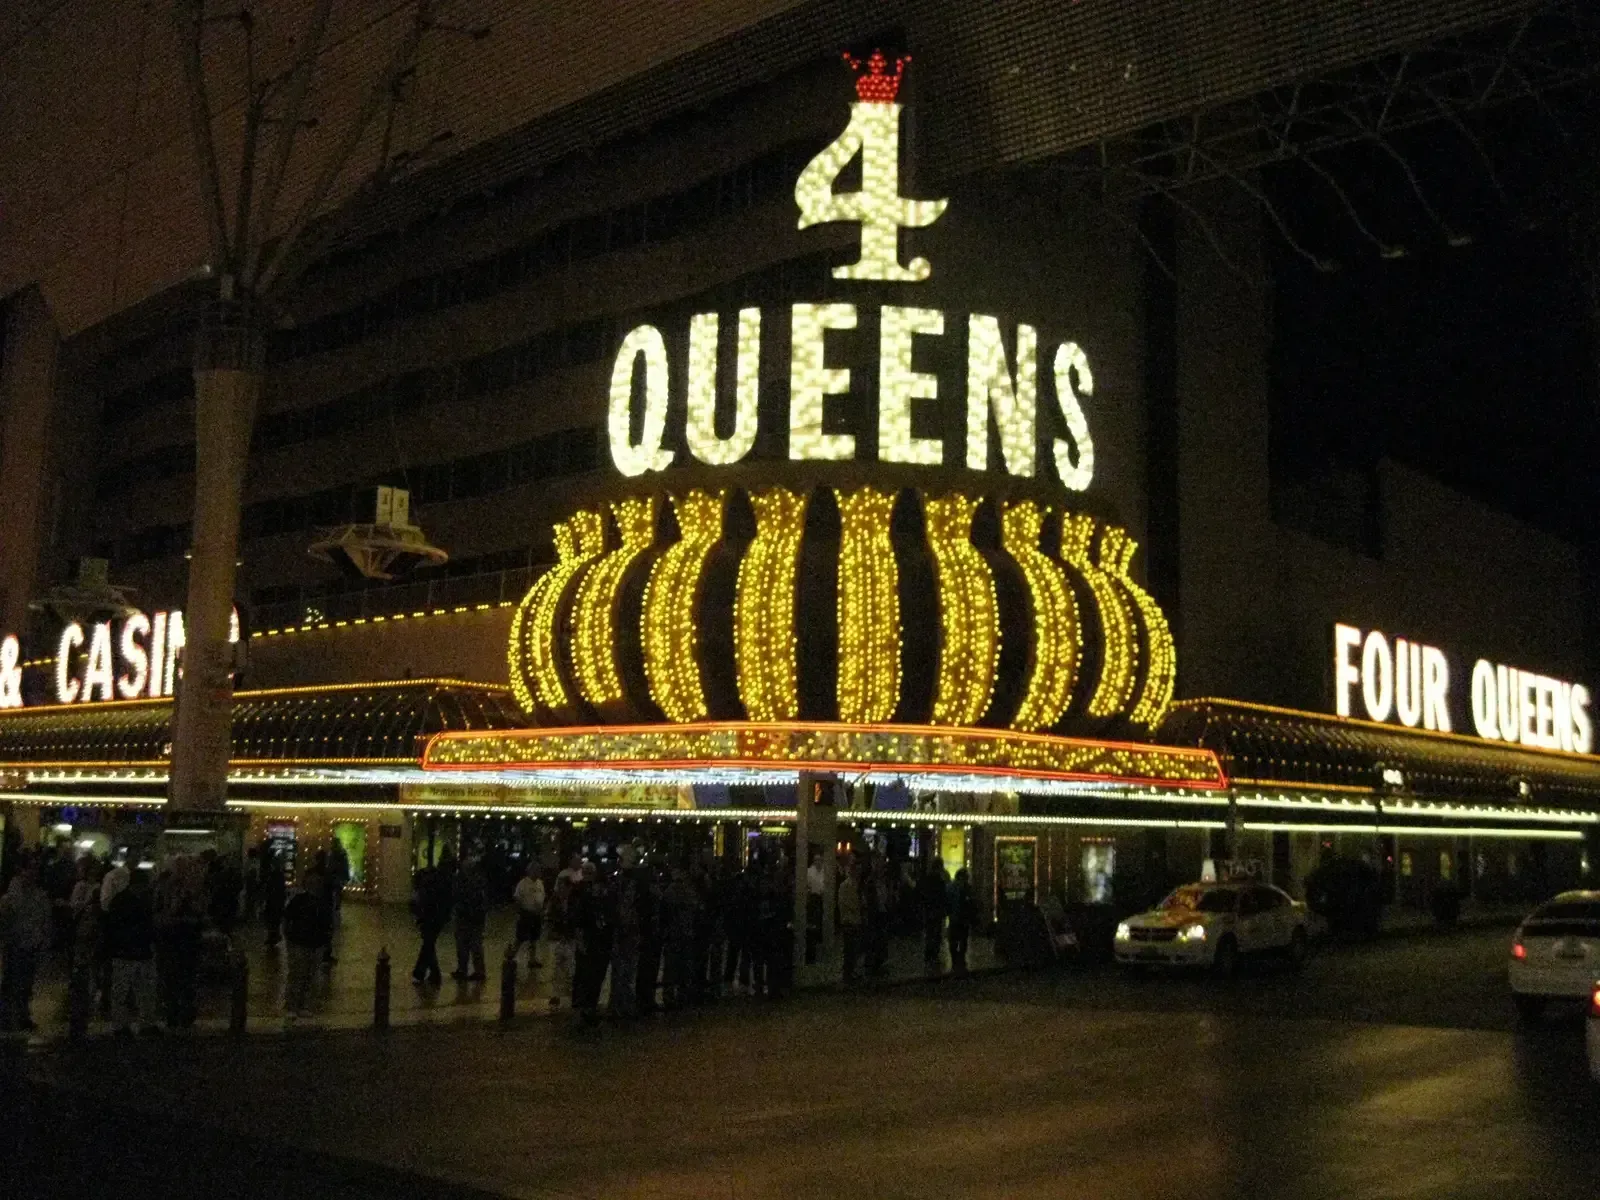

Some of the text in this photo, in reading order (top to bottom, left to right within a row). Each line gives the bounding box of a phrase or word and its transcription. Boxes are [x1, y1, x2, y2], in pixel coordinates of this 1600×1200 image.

[794, 102, 949, 280] 4
[608, 303, 1095, 492] QUEENS
[0, 606, 239, 708] & CASIN
[1335, 623, 1593, 754] FOUR QUEENS
